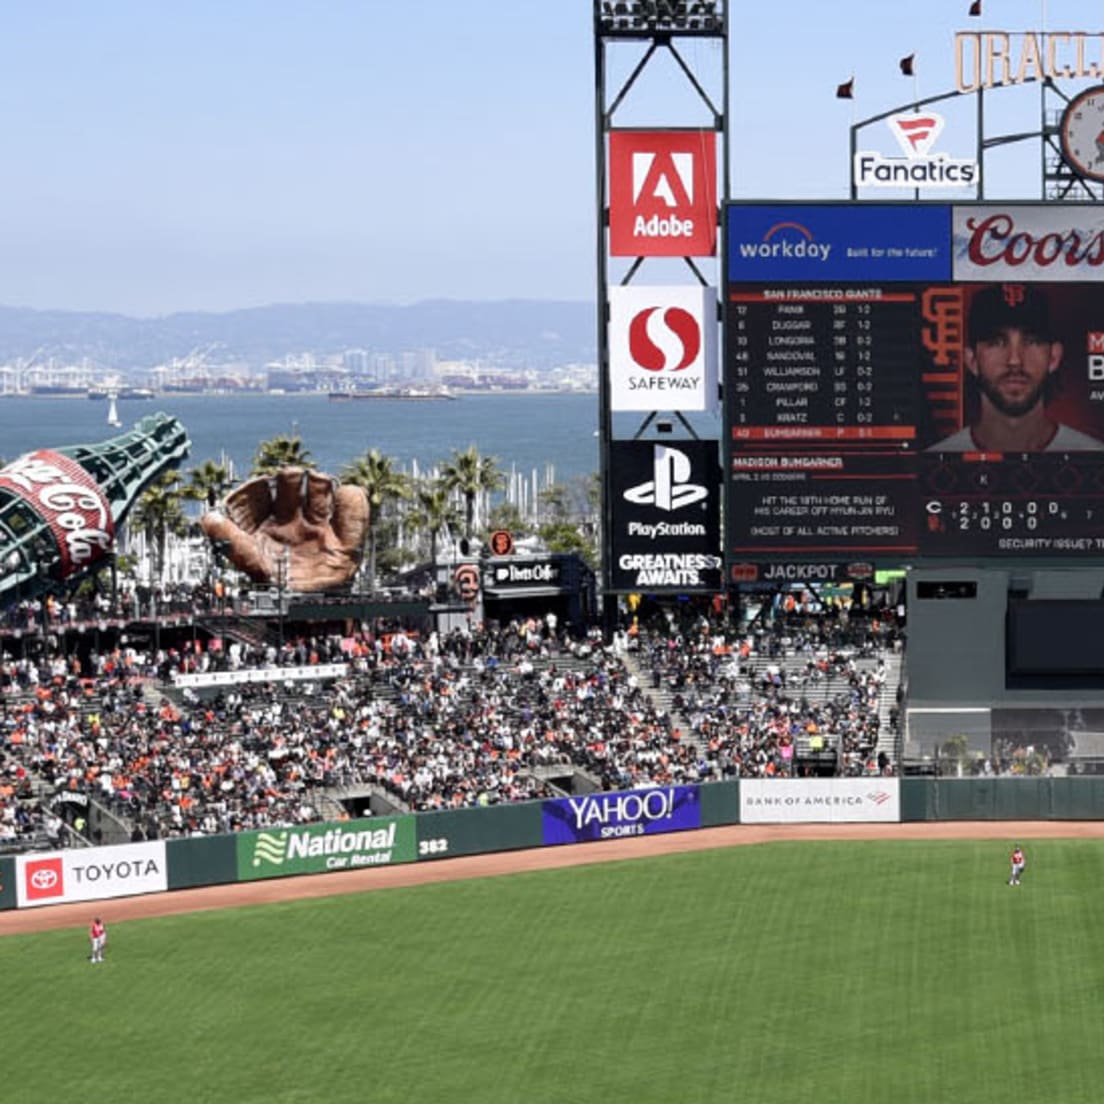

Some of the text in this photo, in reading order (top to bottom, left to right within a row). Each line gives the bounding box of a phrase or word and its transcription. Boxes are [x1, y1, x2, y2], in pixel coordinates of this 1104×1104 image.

[860, 157, 974, 182] Fanatics
[633, 215, 694, 237] Adobe
[740, 239, 831, 262] workday
[628, 377, 700, 391] SAFEWAY
[628, 522, 706, 539] PlayStation
[636, 570, 700, 586] AWAITS
[764, 565, 838, 578] JACKPOT
[568, 789, 675, 829] YAHOO!
[747, 796, 863, 806] BANK OF AMERICA
[601, 823, 645, 838] SPORTS
[287, 823, 396, 859] National
[326, 851, 391, 868] Car Rental
[72, 859, 159, 884] TOYOTA
